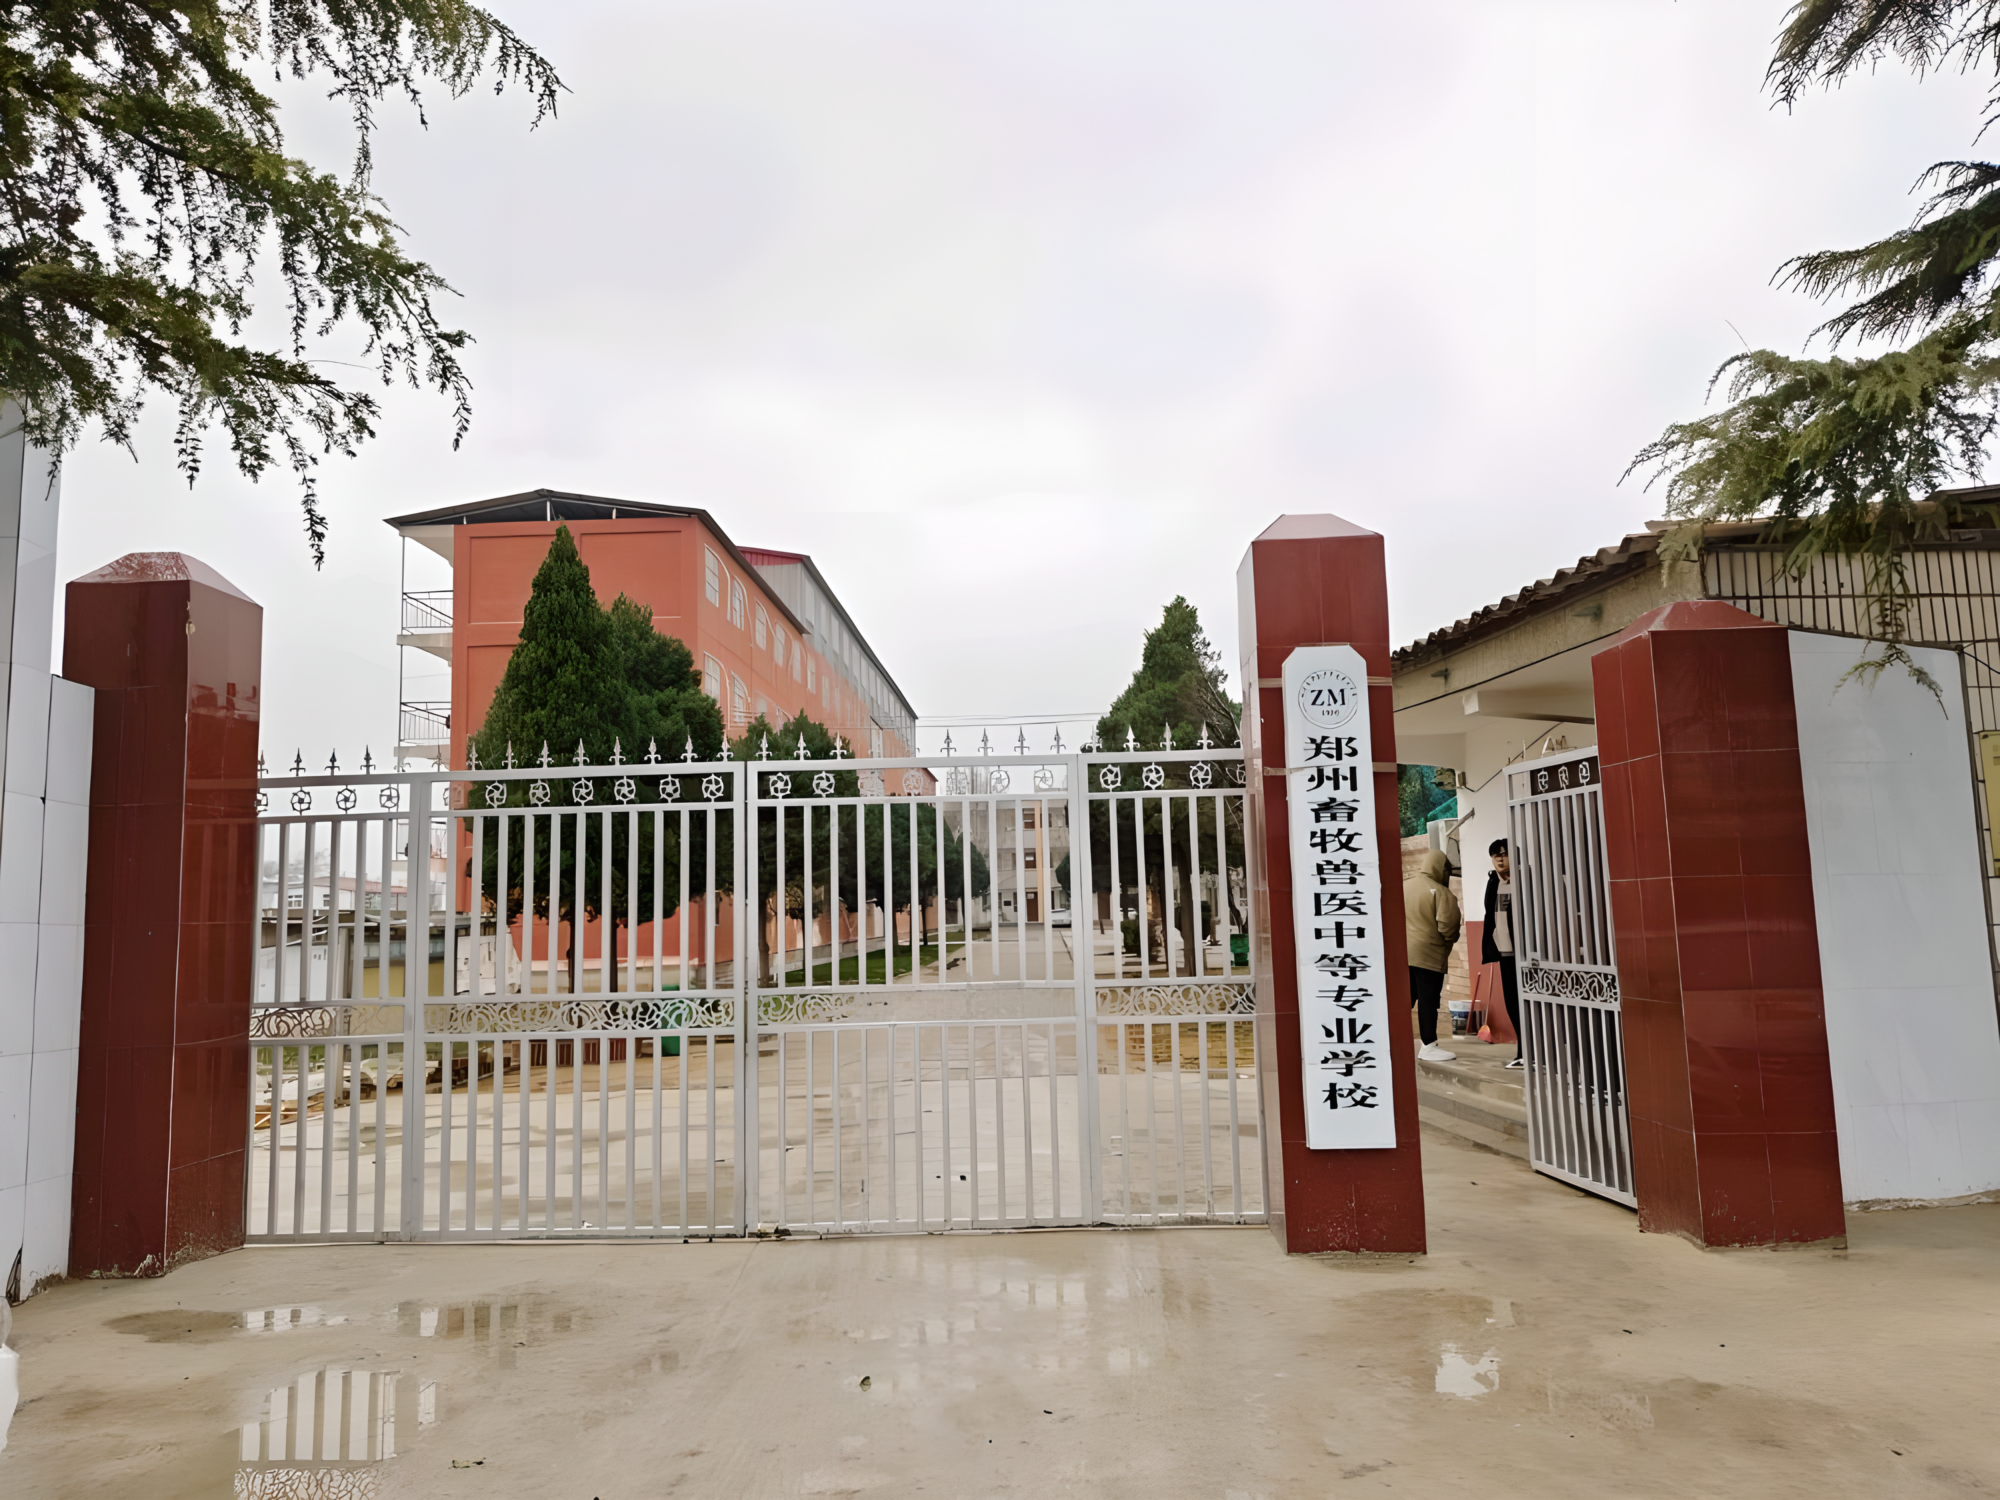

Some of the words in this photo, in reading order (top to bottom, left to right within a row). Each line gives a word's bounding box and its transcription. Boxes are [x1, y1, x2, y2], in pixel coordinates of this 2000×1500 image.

[1311, 689, 1346, 706] ZM
[1304, 735, 1379, 1110] 郑州畜牧兽医中等专业学校
